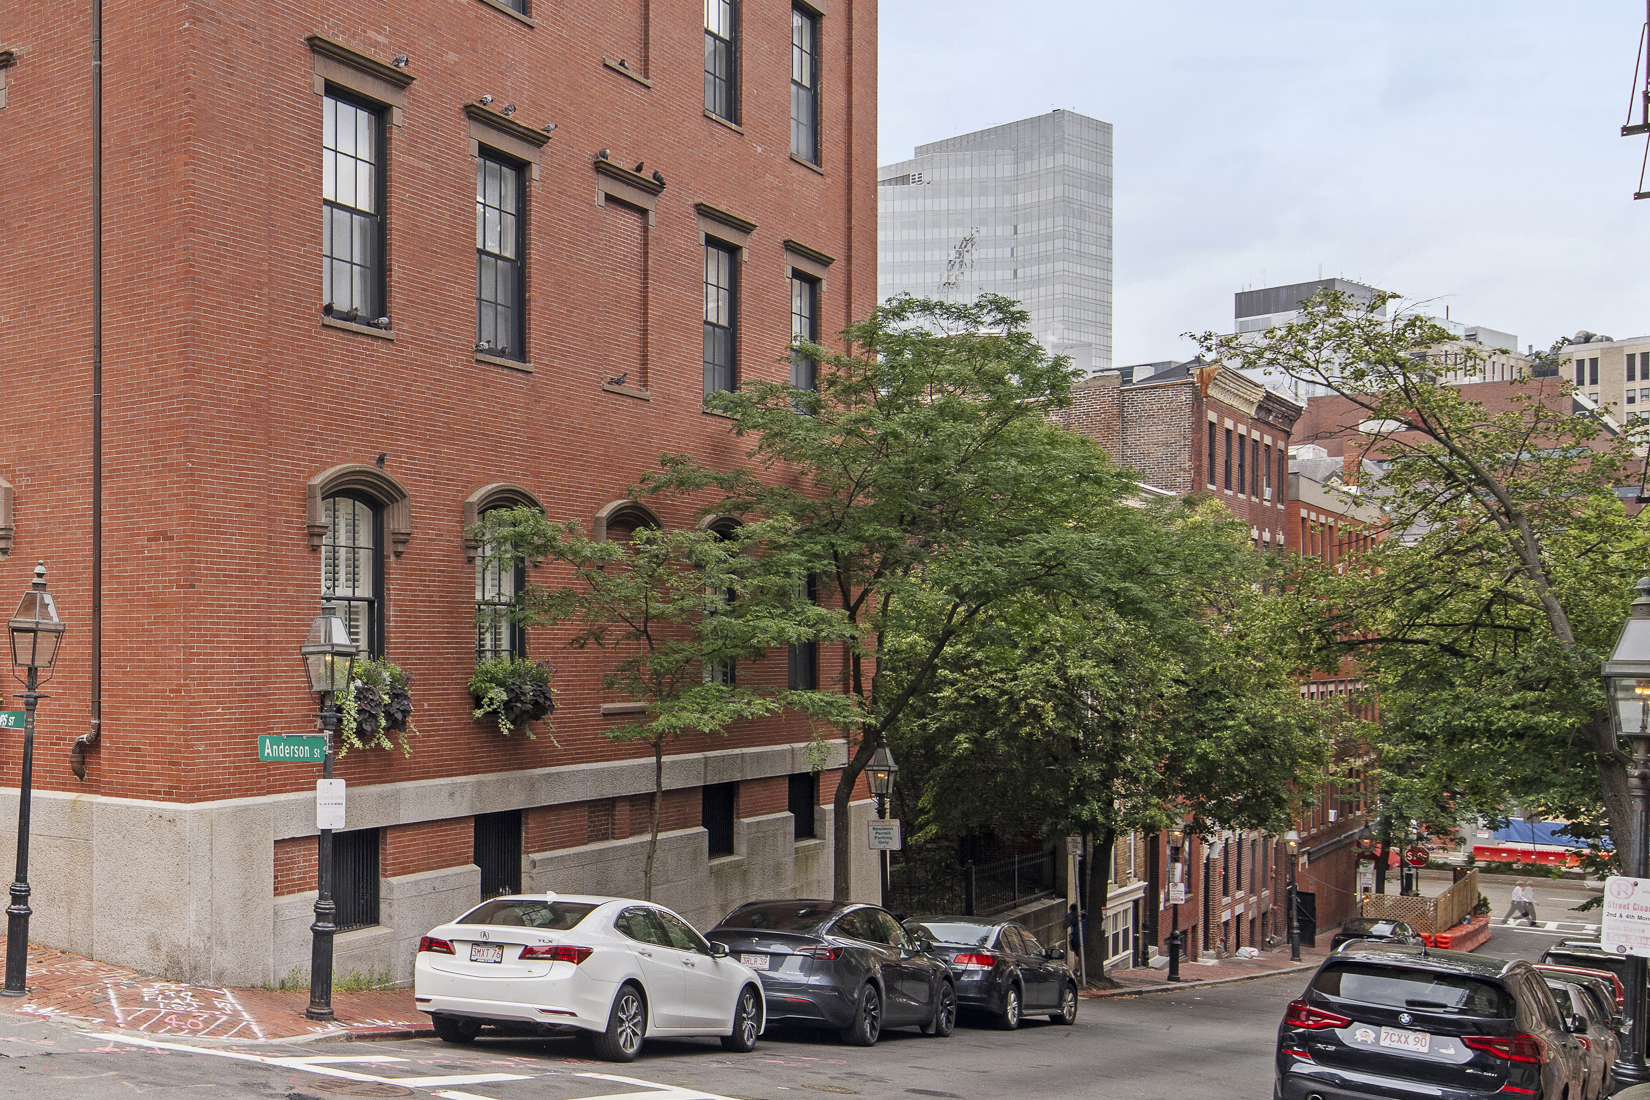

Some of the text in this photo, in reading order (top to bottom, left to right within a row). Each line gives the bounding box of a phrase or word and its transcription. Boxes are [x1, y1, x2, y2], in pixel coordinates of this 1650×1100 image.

[8, 716, 15, 726] ST
[264, 738, 321, 758] Anderson St
[1607, 900, 1630, 911] Street
[471, 947, 501, 959] 3MXT 76
[759, 957, 768, 965] 39
[1382, 1031, 1427, 1048] 7CXX 90
